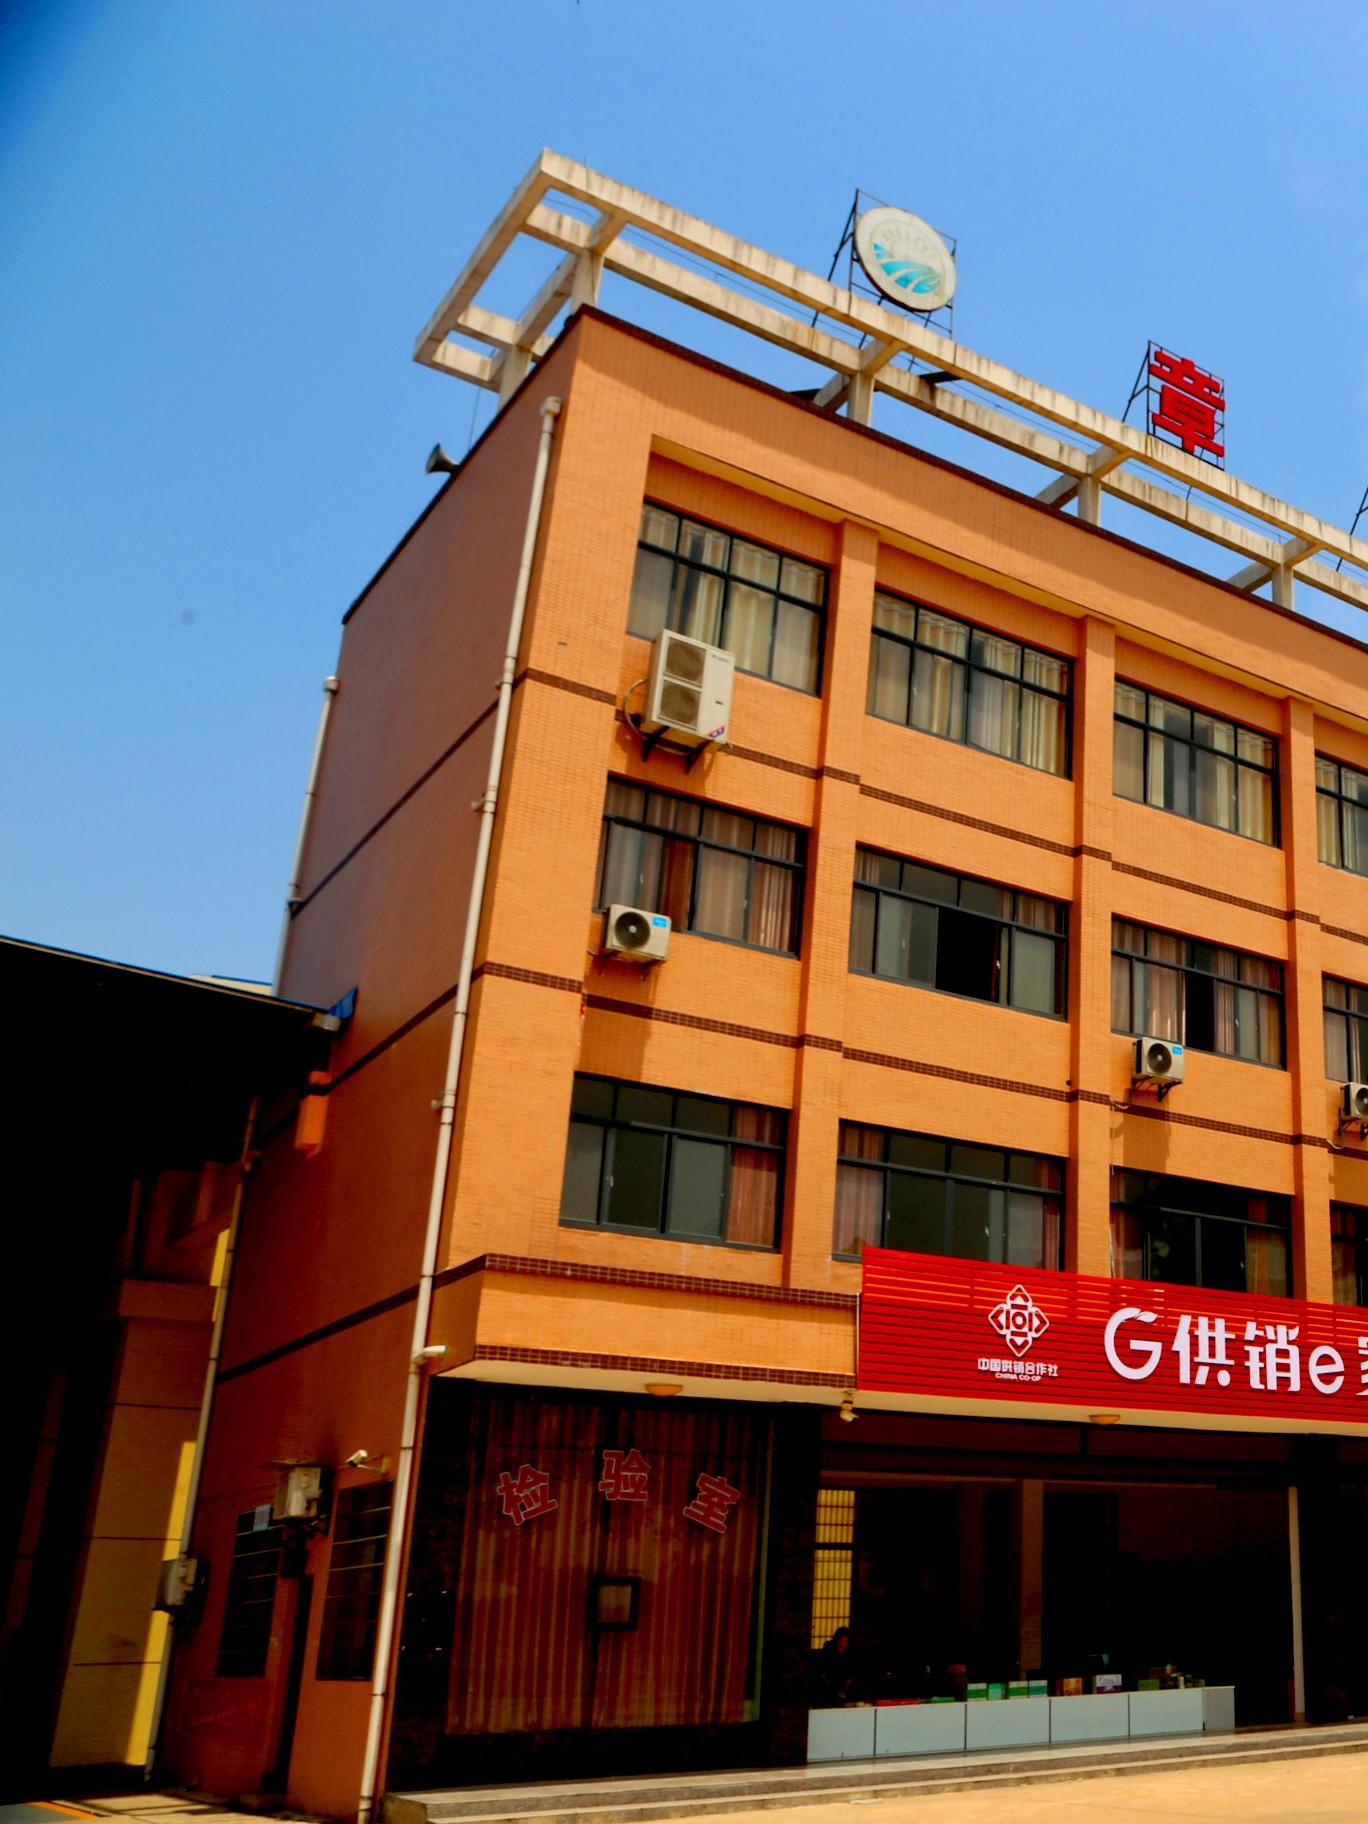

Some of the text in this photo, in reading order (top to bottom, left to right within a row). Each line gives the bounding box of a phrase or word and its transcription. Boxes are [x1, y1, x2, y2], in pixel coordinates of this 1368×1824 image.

[977, 1358, 1058, 1376] 中国供销合作社
[497, 1448, 741, 1534] 检验室
